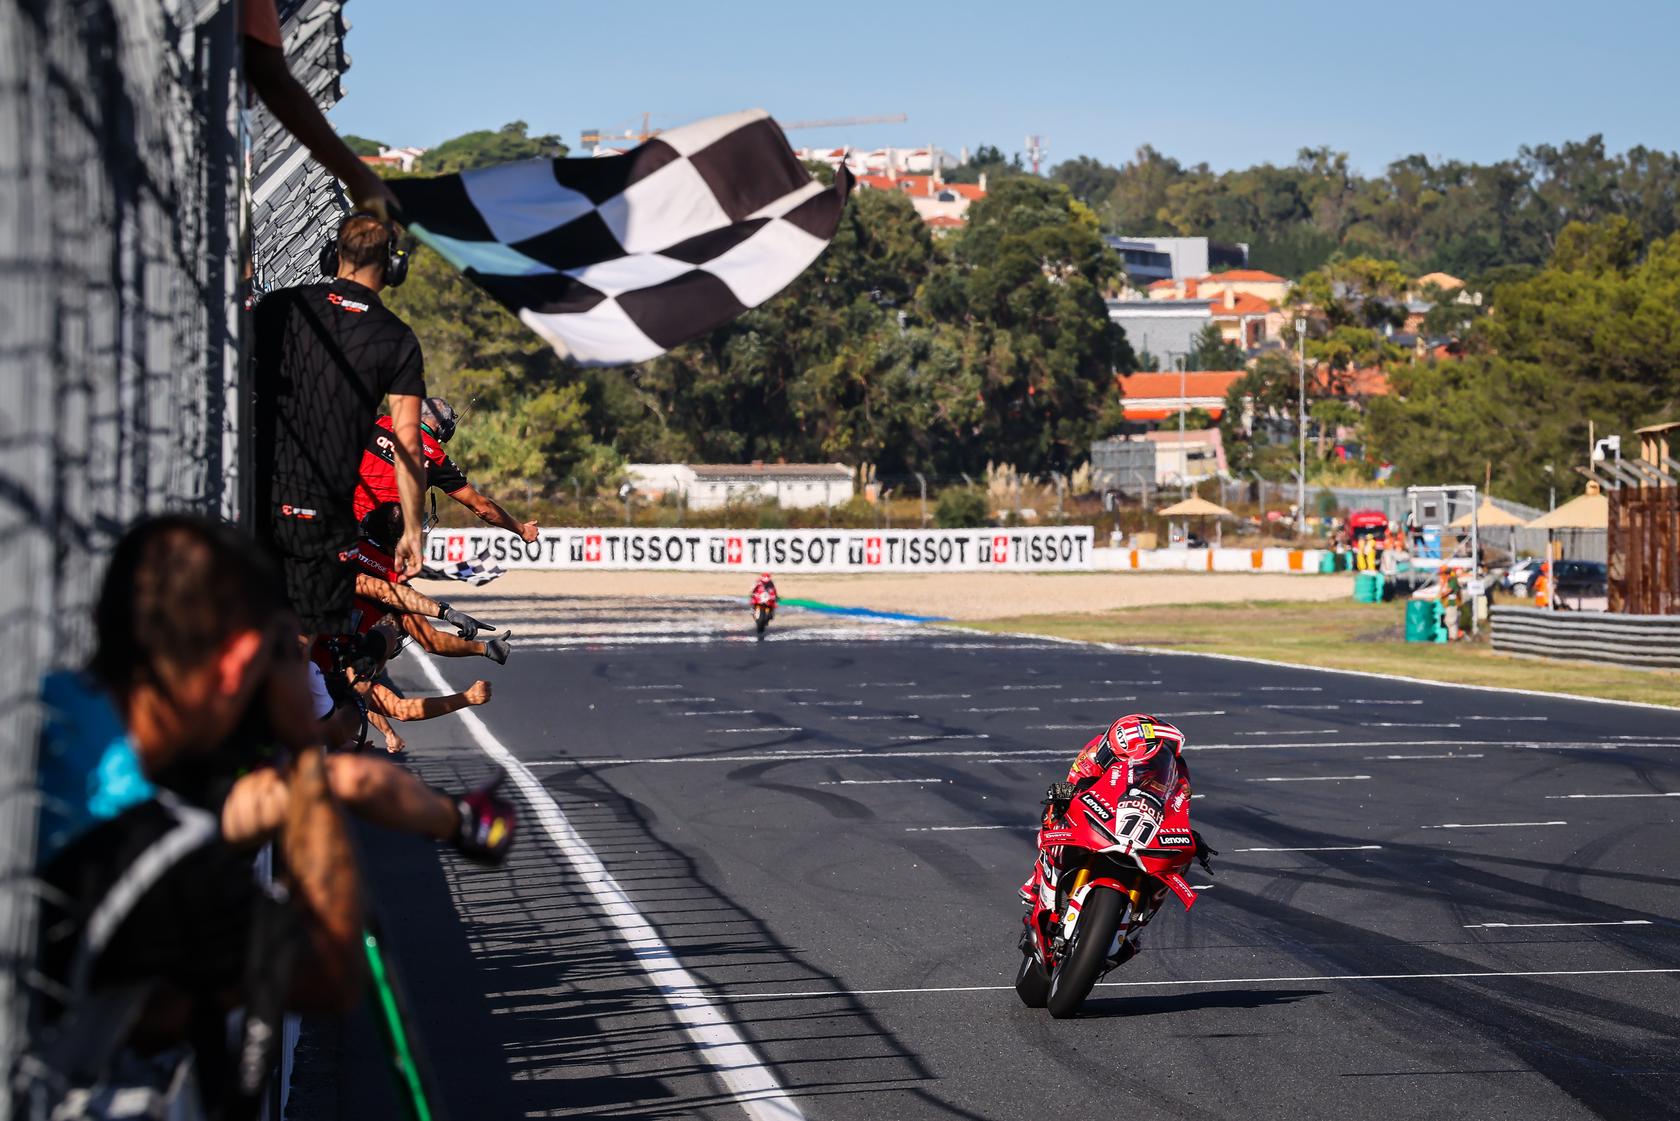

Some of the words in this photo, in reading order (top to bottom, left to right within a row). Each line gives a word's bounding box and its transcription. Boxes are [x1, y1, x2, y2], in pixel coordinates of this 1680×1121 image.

[470, 536, 561, 562] TISSOT
[606, 536, 701, 562] TISSOT
[747, 537, 841, 564] TISSOT
[886, 536, 970, 564] TISSOT
[1011, 535, 1087, 563] TISSOT
[1082, 794, 1109, 819] Lenovo
[1117, 798, 1164, 825] aruba.it
[1119, 812, 1157, 846] 11
[1159, 836, 1190, 845] Lenovo
